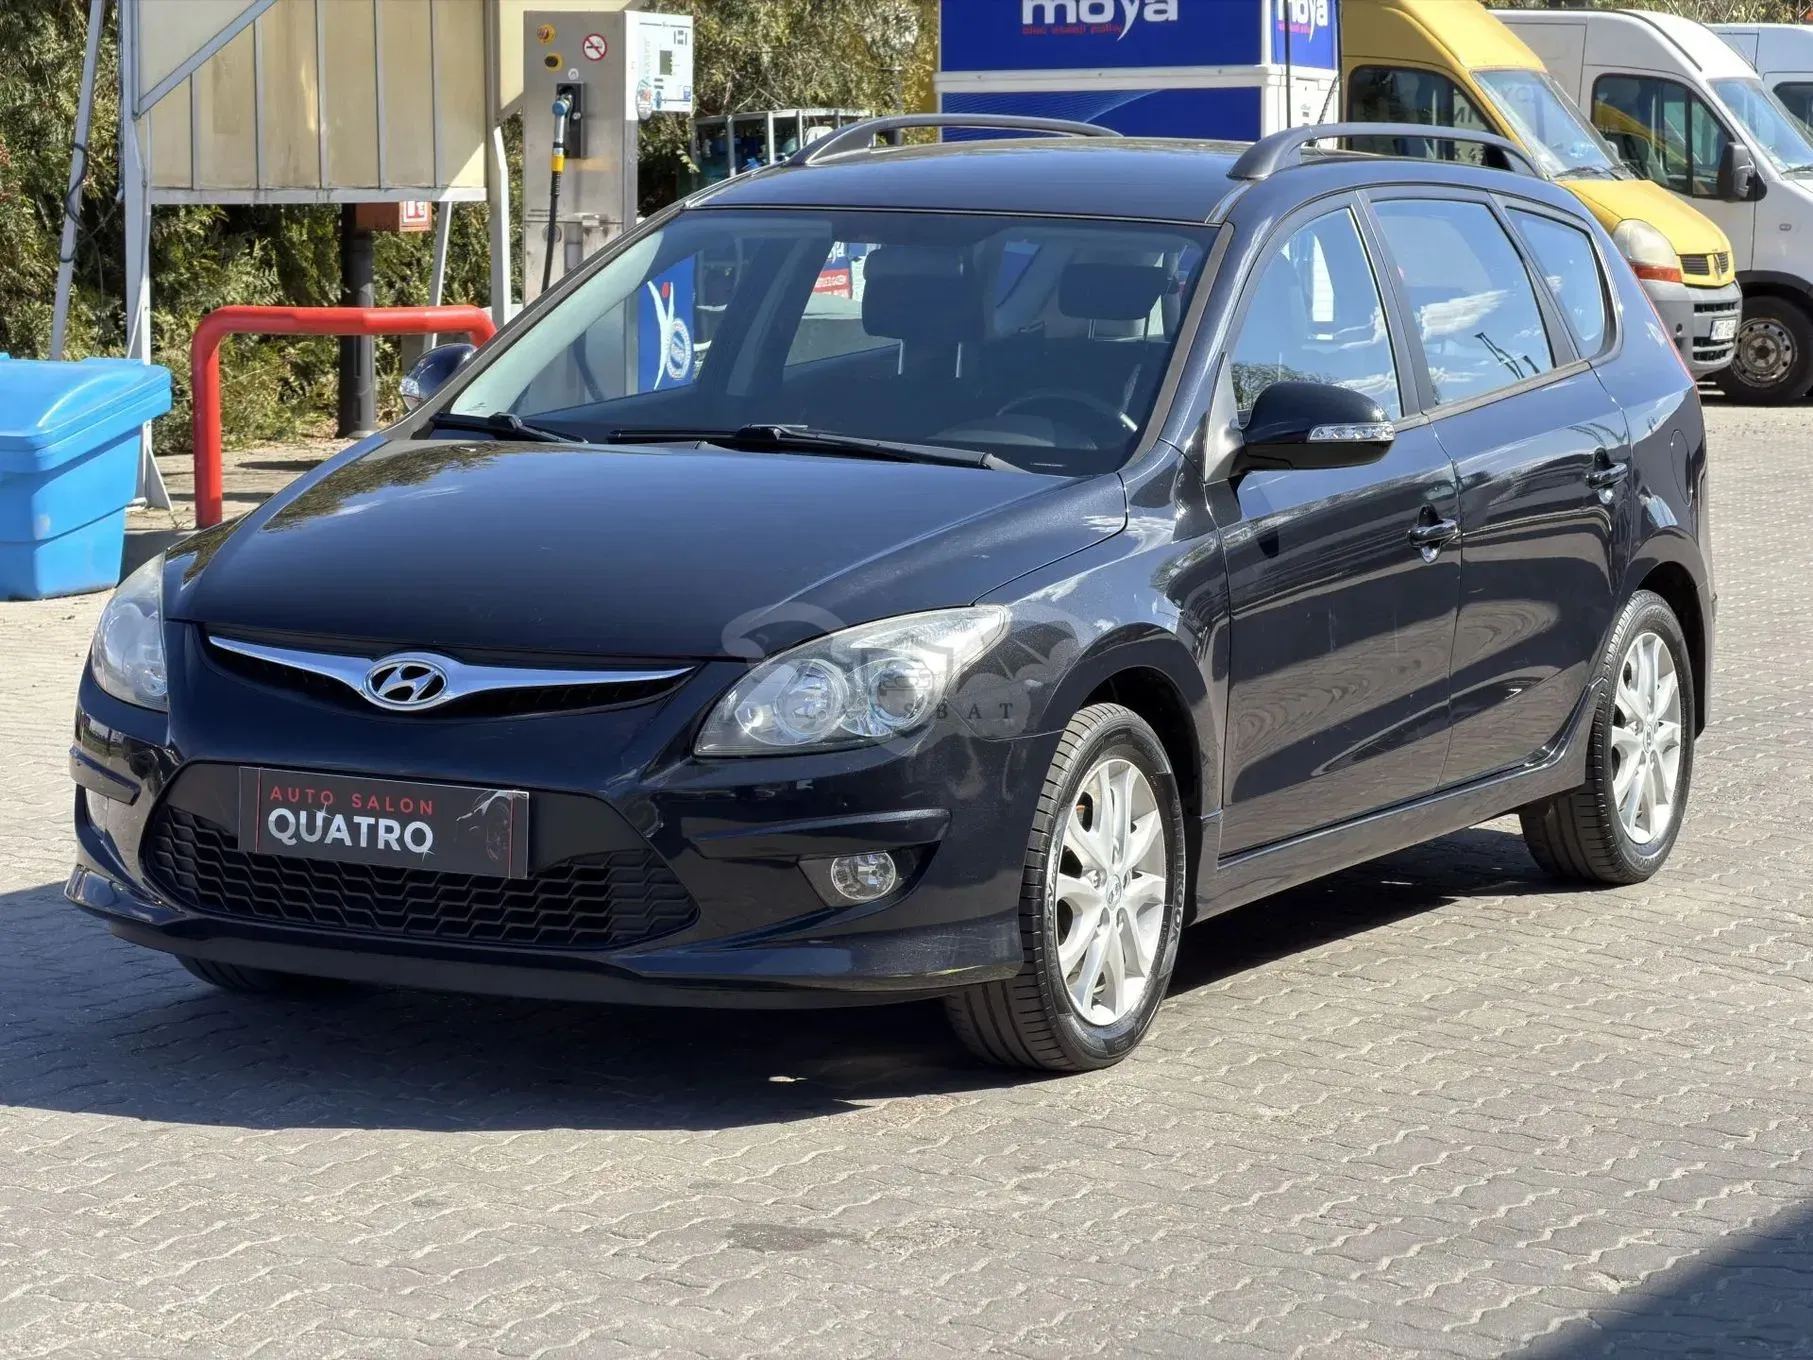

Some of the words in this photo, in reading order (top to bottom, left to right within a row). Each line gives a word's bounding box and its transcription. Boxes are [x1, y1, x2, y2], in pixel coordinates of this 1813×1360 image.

[1022, 0, 1178, 41] moya
[270, 786, 334, 805] AUTO
[351, 793, 433, 815] SALON
[268, 807, 434, 854] QUATRO
